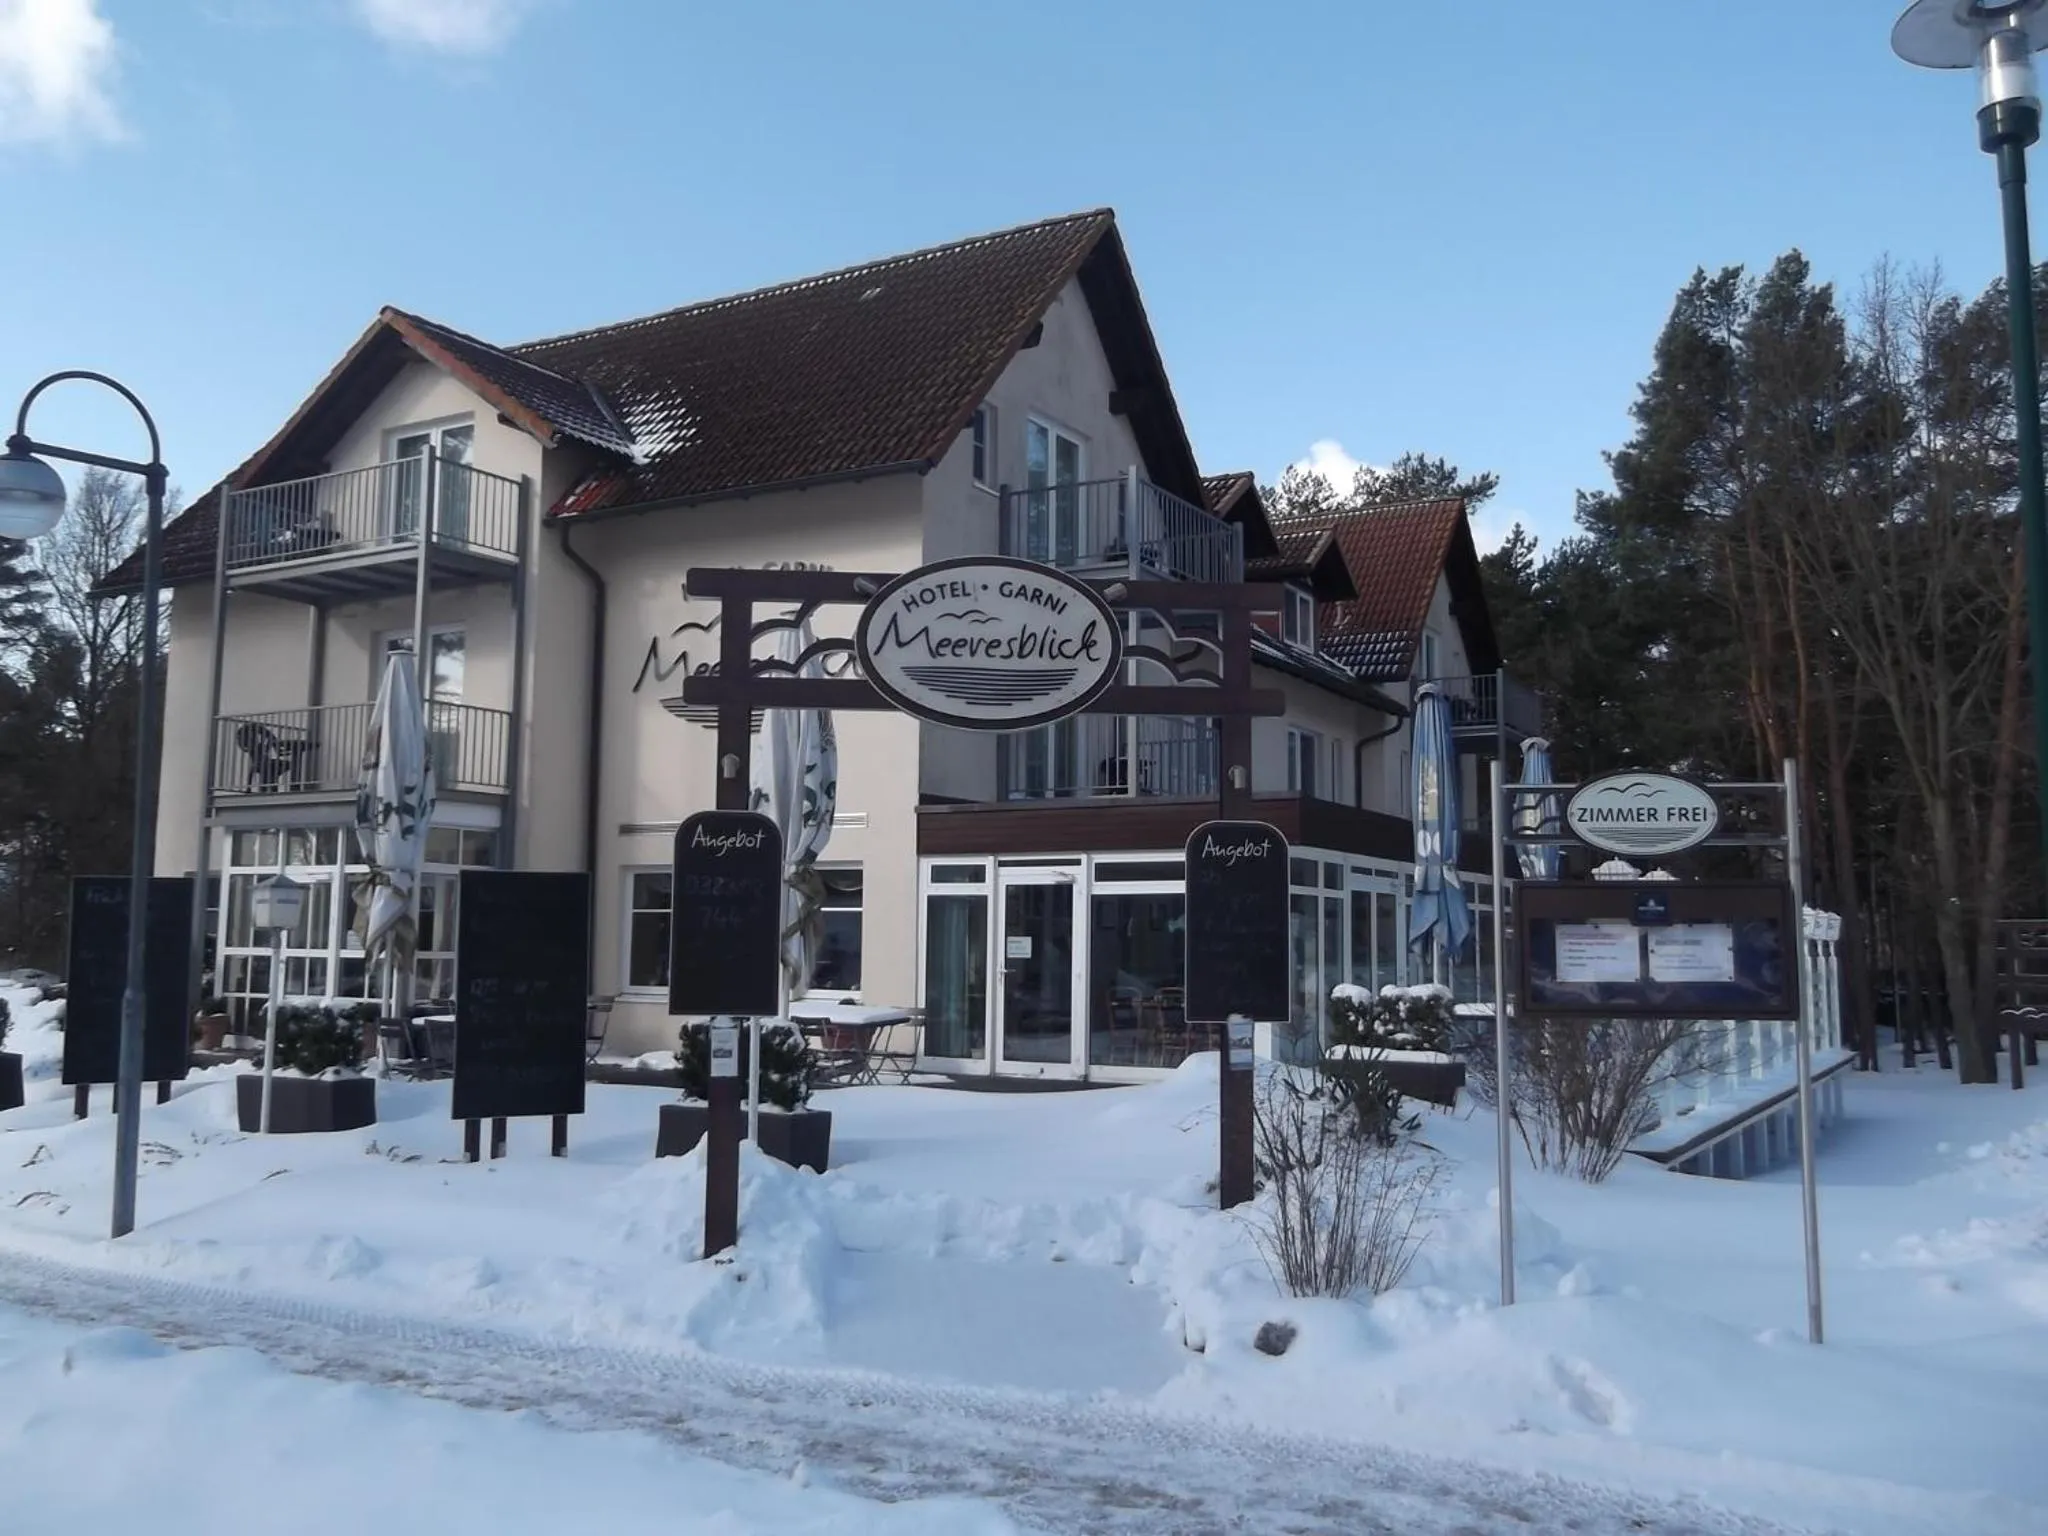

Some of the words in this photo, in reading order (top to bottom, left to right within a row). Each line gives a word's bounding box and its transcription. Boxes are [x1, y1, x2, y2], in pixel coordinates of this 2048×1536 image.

[901, 581, 971, 613] HOTEL
[999, 581, 1068, 615] GARNI
[873, 612, 1101, 662] Meeresblick
[1577, 807, 1659, 823] ZIMMER
[1667, 807, 1708, 823] FREI
[691, 824, 766, 857] Angebot
[1201, 834, 1272, 867] Angebot
